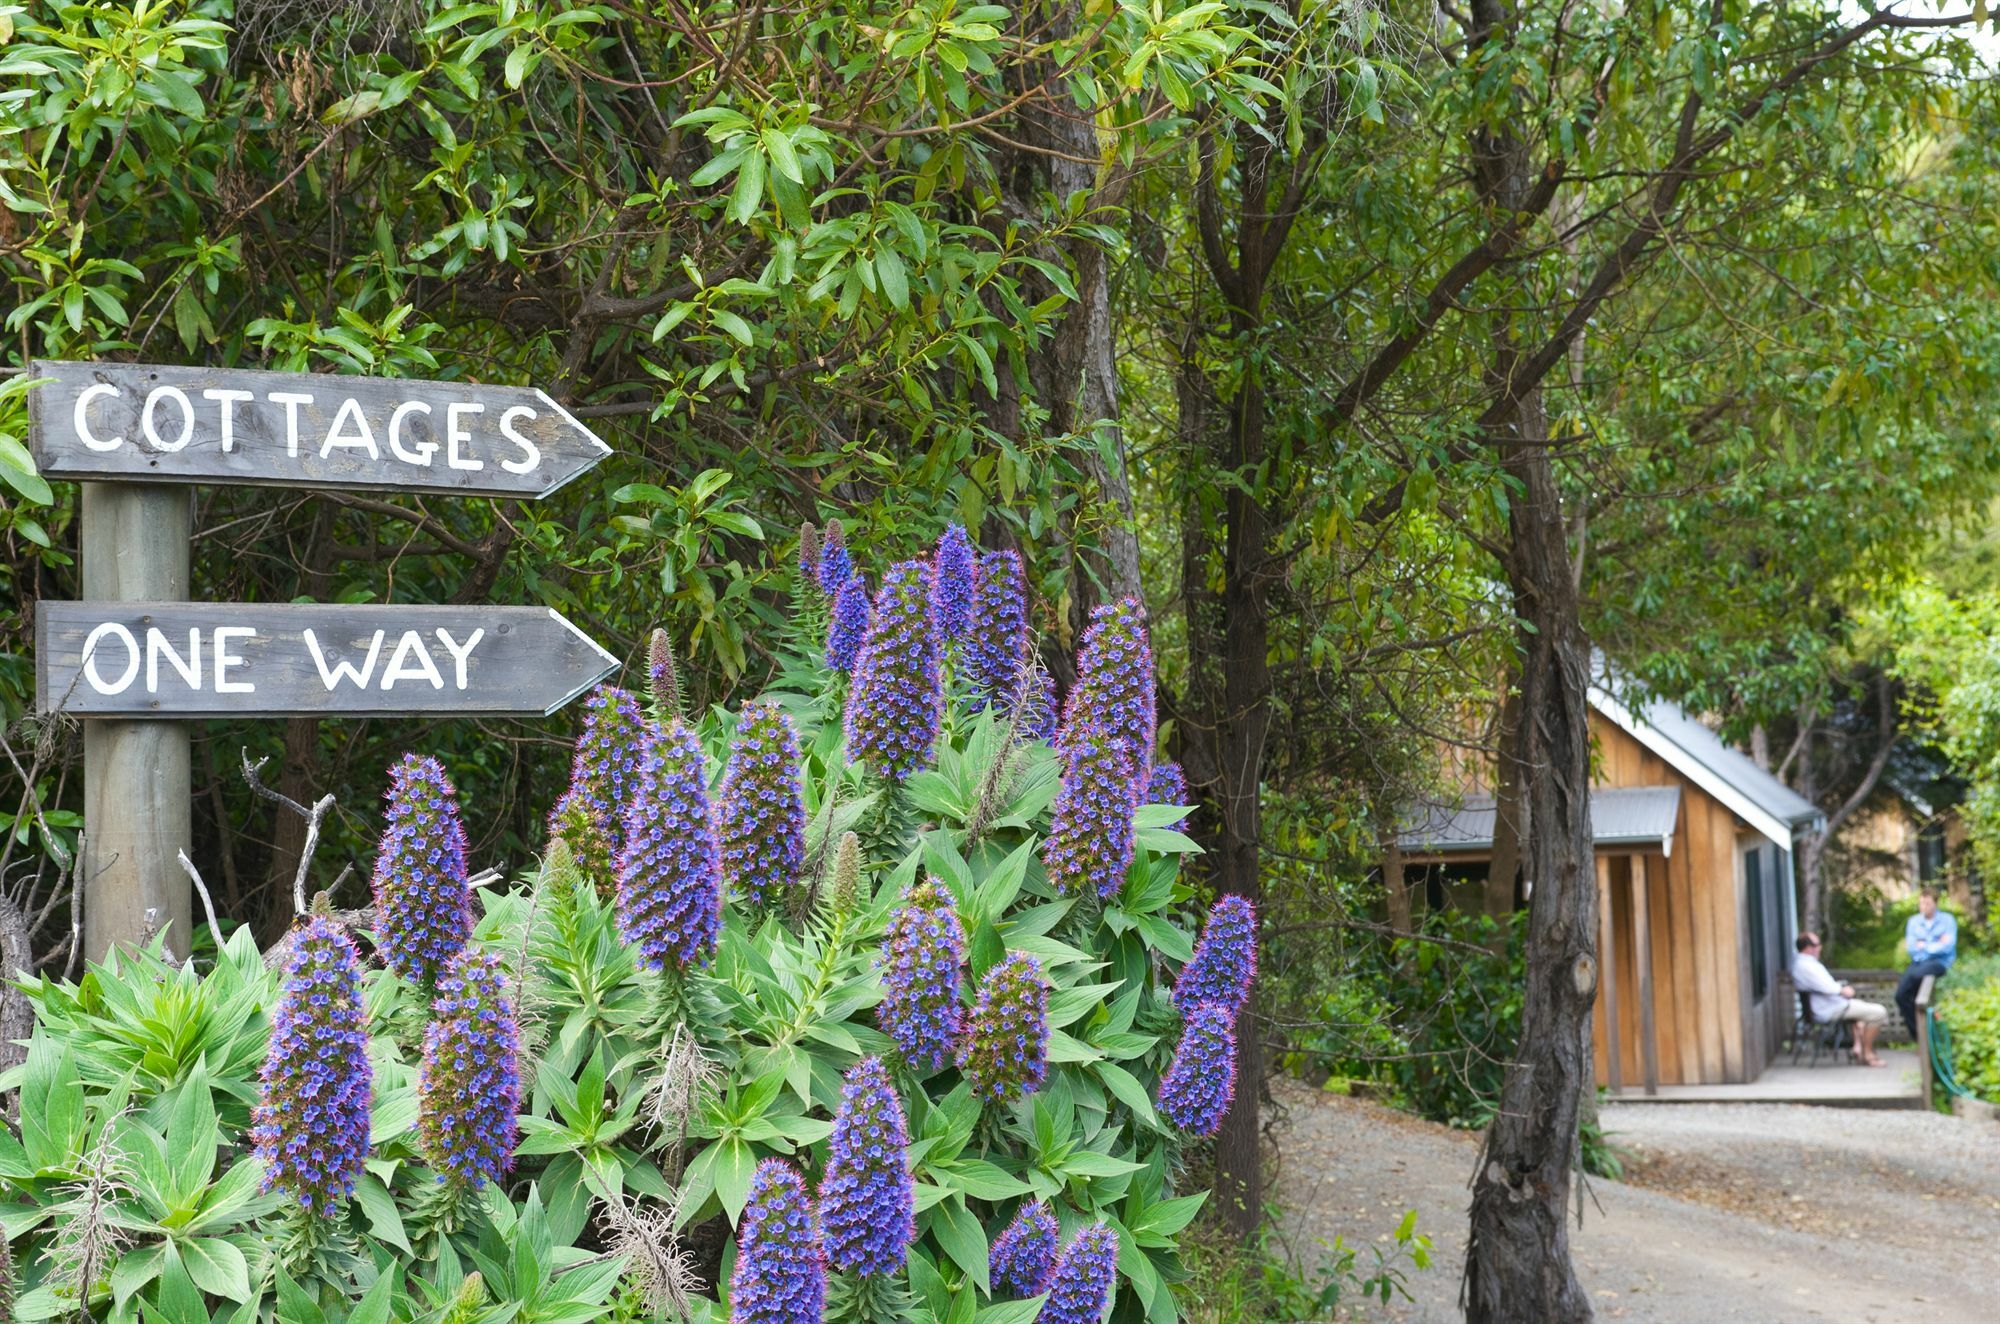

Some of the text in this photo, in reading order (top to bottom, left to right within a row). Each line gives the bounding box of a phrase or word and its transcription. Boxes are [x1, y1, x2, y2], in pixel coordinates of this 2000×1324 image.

[73, 382, 542, 475] COTTAGES
[81, 622, 486, 696] ONE WAY
